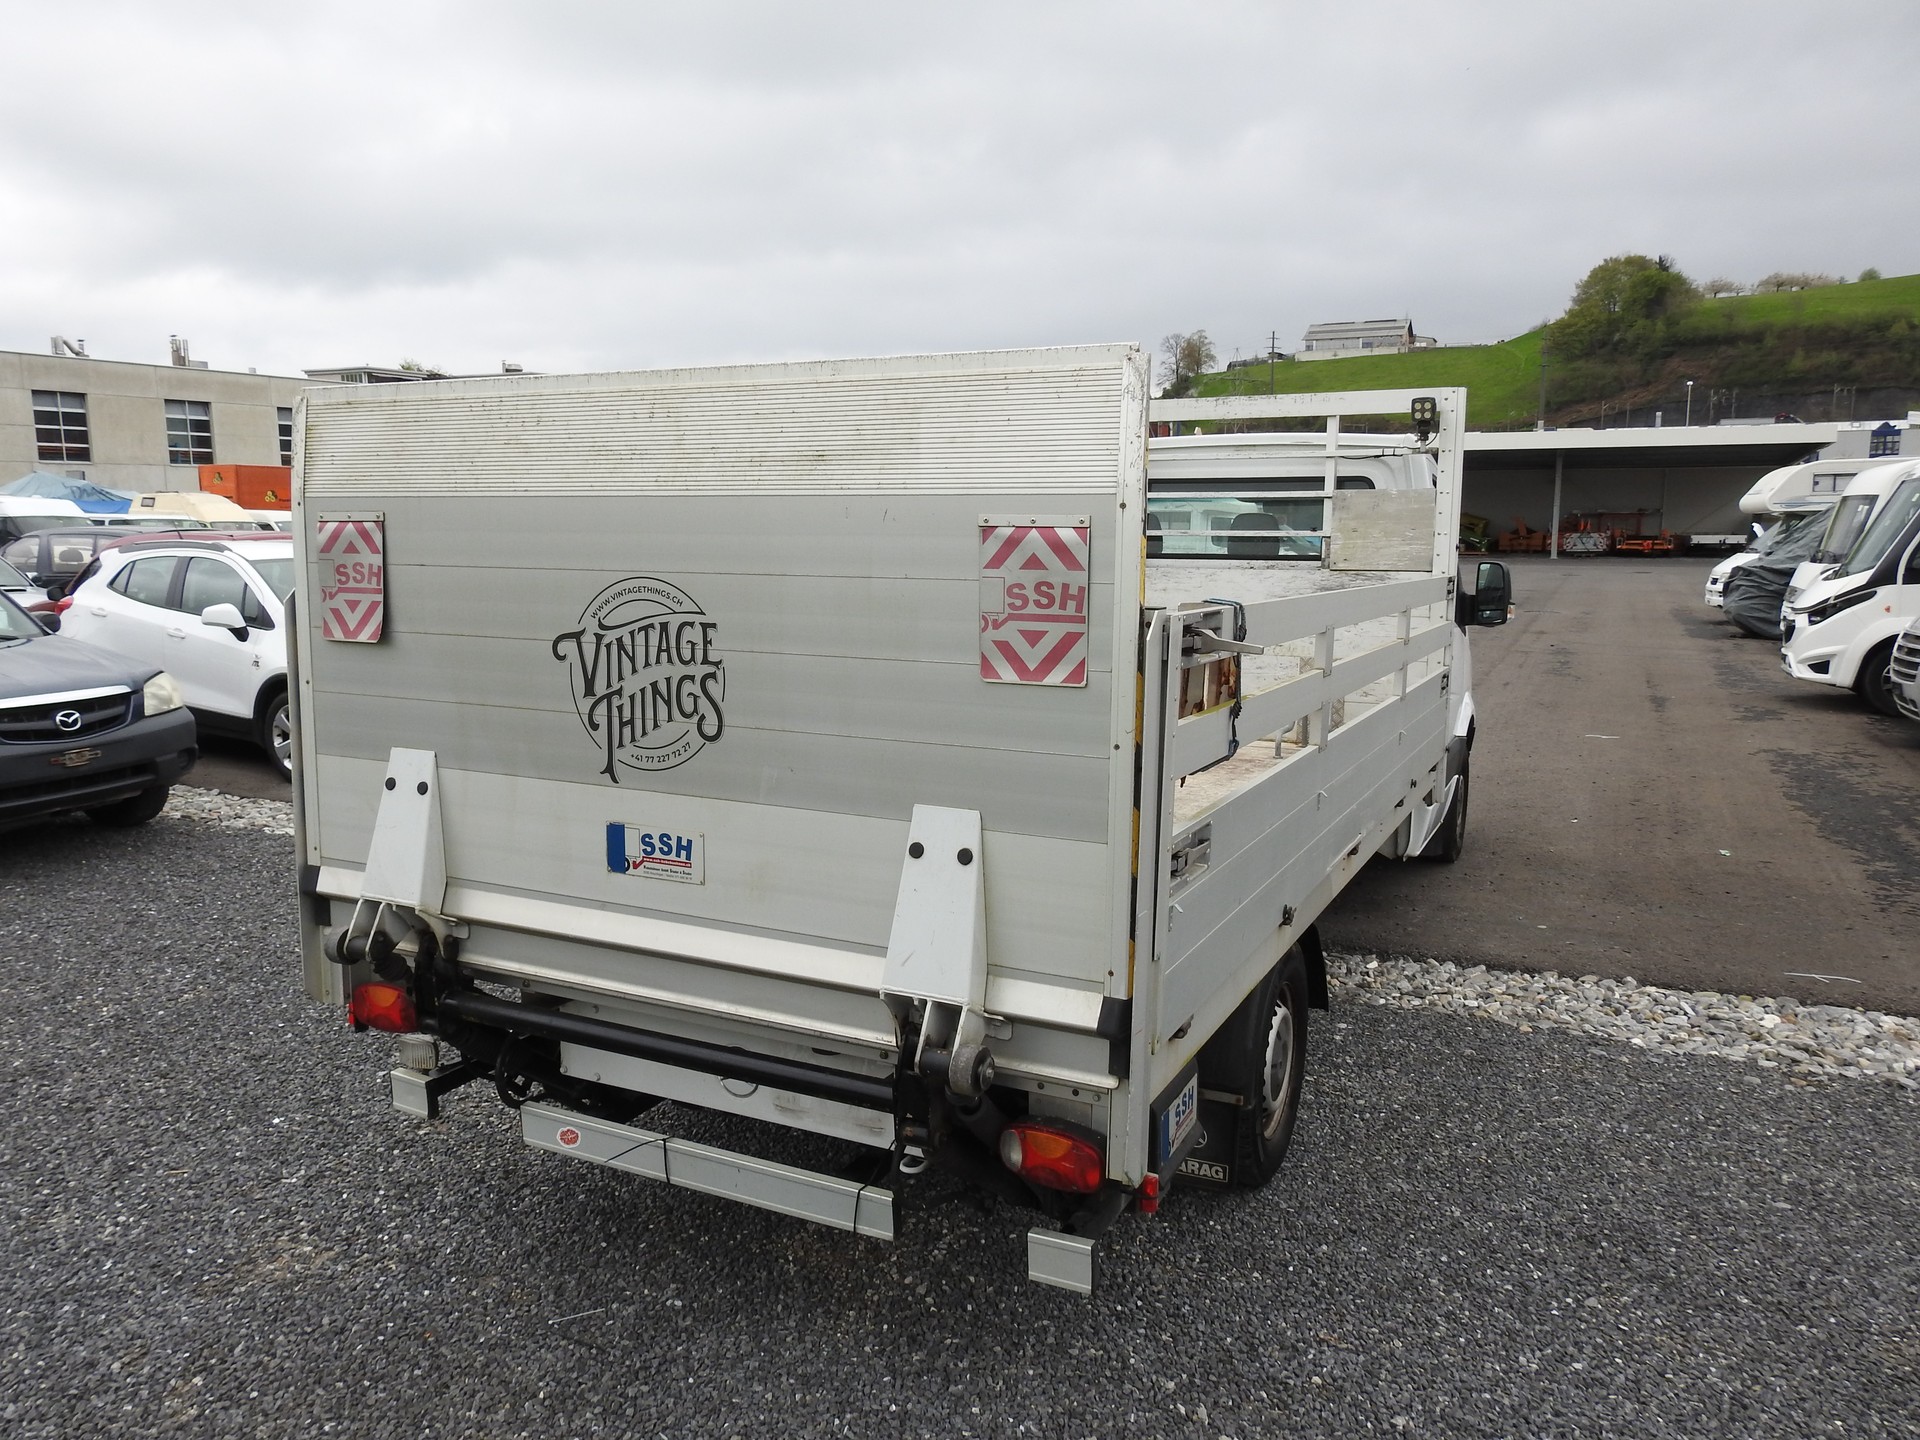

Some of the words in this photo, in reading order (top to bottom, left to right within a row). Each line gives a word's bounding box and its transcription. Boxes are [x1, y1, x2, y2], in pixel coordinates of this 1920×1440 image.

[335, 562, 383, 587] SSH
[590, 586, 684, 619] WWW.VINTAGETHINGS.CH
[1006, 581, 1086, 614] SSH
[552, 620, 723, 699] VINTAGE
[588, 670, 724, 784] THINGS
[630, 754, 643, 762] +41
[645, 755, 655, 763] 77
[656, 753, 670, 763] 227
[681, 741, 691, 753] 27
[640, 833, 693, 861] SSH
[1174, 1085, 1194, 1127] SSH
